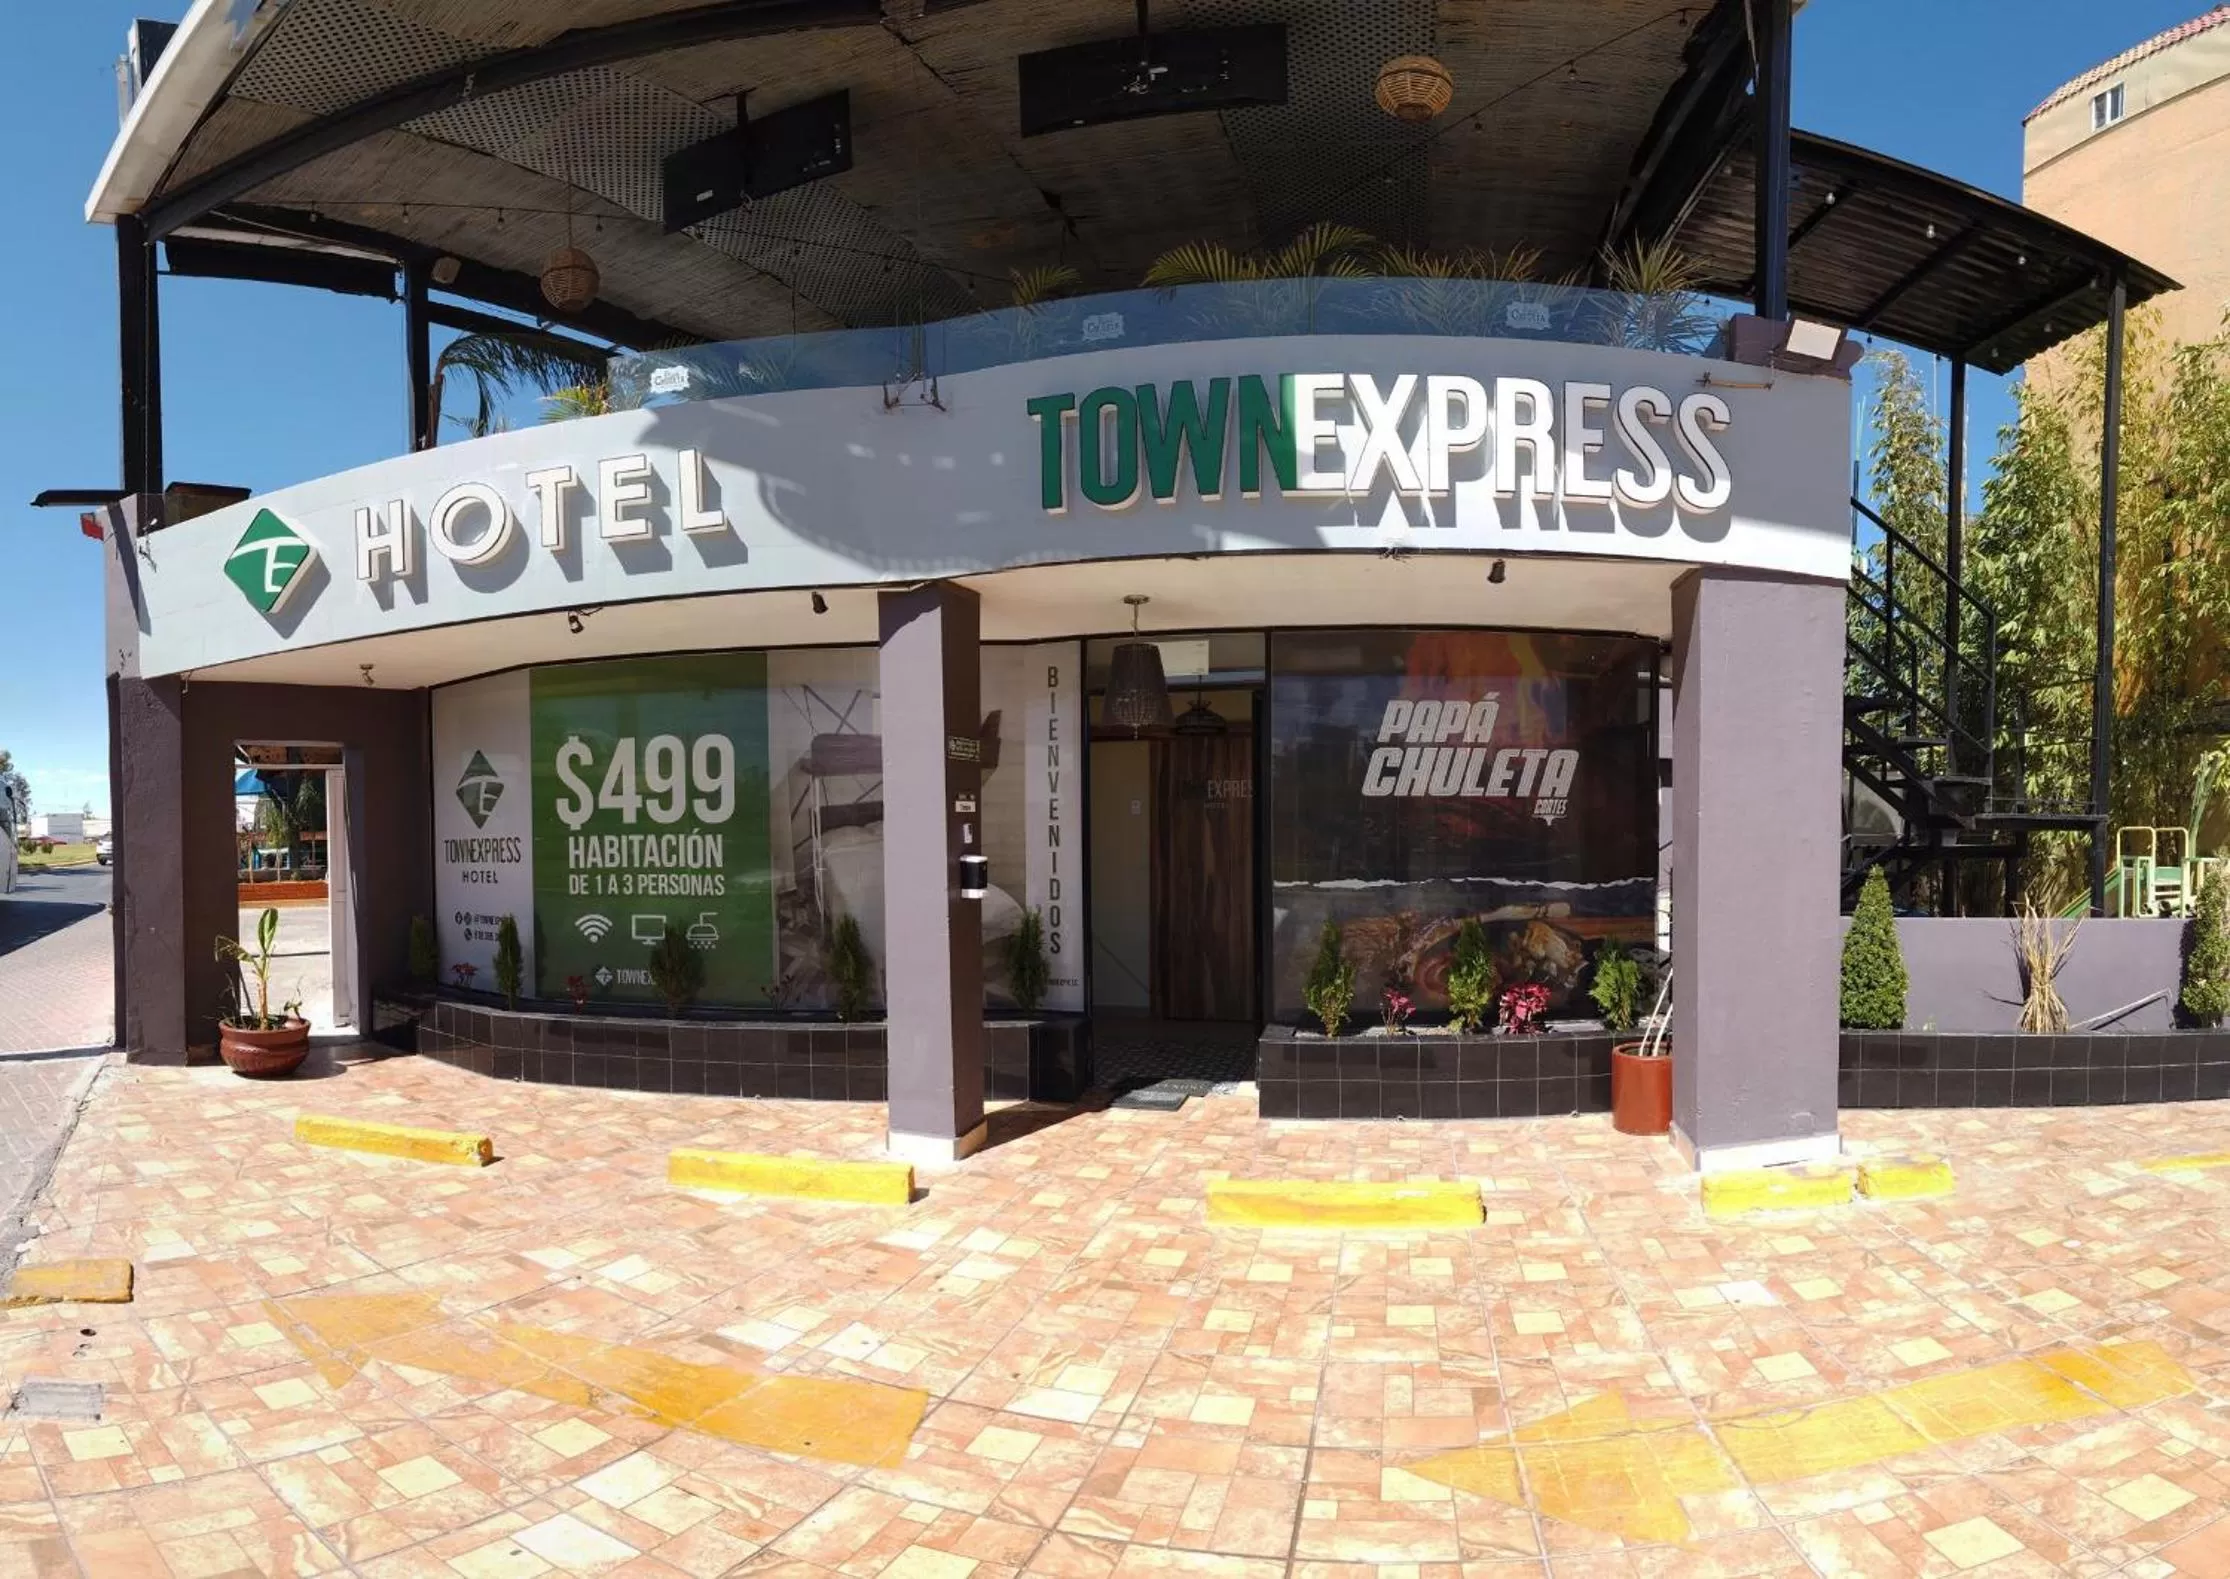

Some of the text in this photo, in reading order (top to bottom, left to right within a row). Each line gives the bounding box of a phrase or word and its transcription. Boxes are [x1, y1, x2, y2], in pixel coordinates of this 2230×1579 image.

[354, 447, 729, 583] HOTEL
[1376, 691, 1501, 743] PAPÁ
[555, 733, 736, 831] $499
[1361, 747, 1580, 797] CHULETA
[1047, 665, 1062, 955] BIENVENIDOS
[1533, 799, 1569, 815] CORTES
[444, 836, 522, 864] TOWNEXPRESS
[568, 828, 724, 869] HABITACIÓN
[462, 870, 499, 884] HOTEL
[569, 872, 726, 897] DE 1 A 3 PERSONAS
